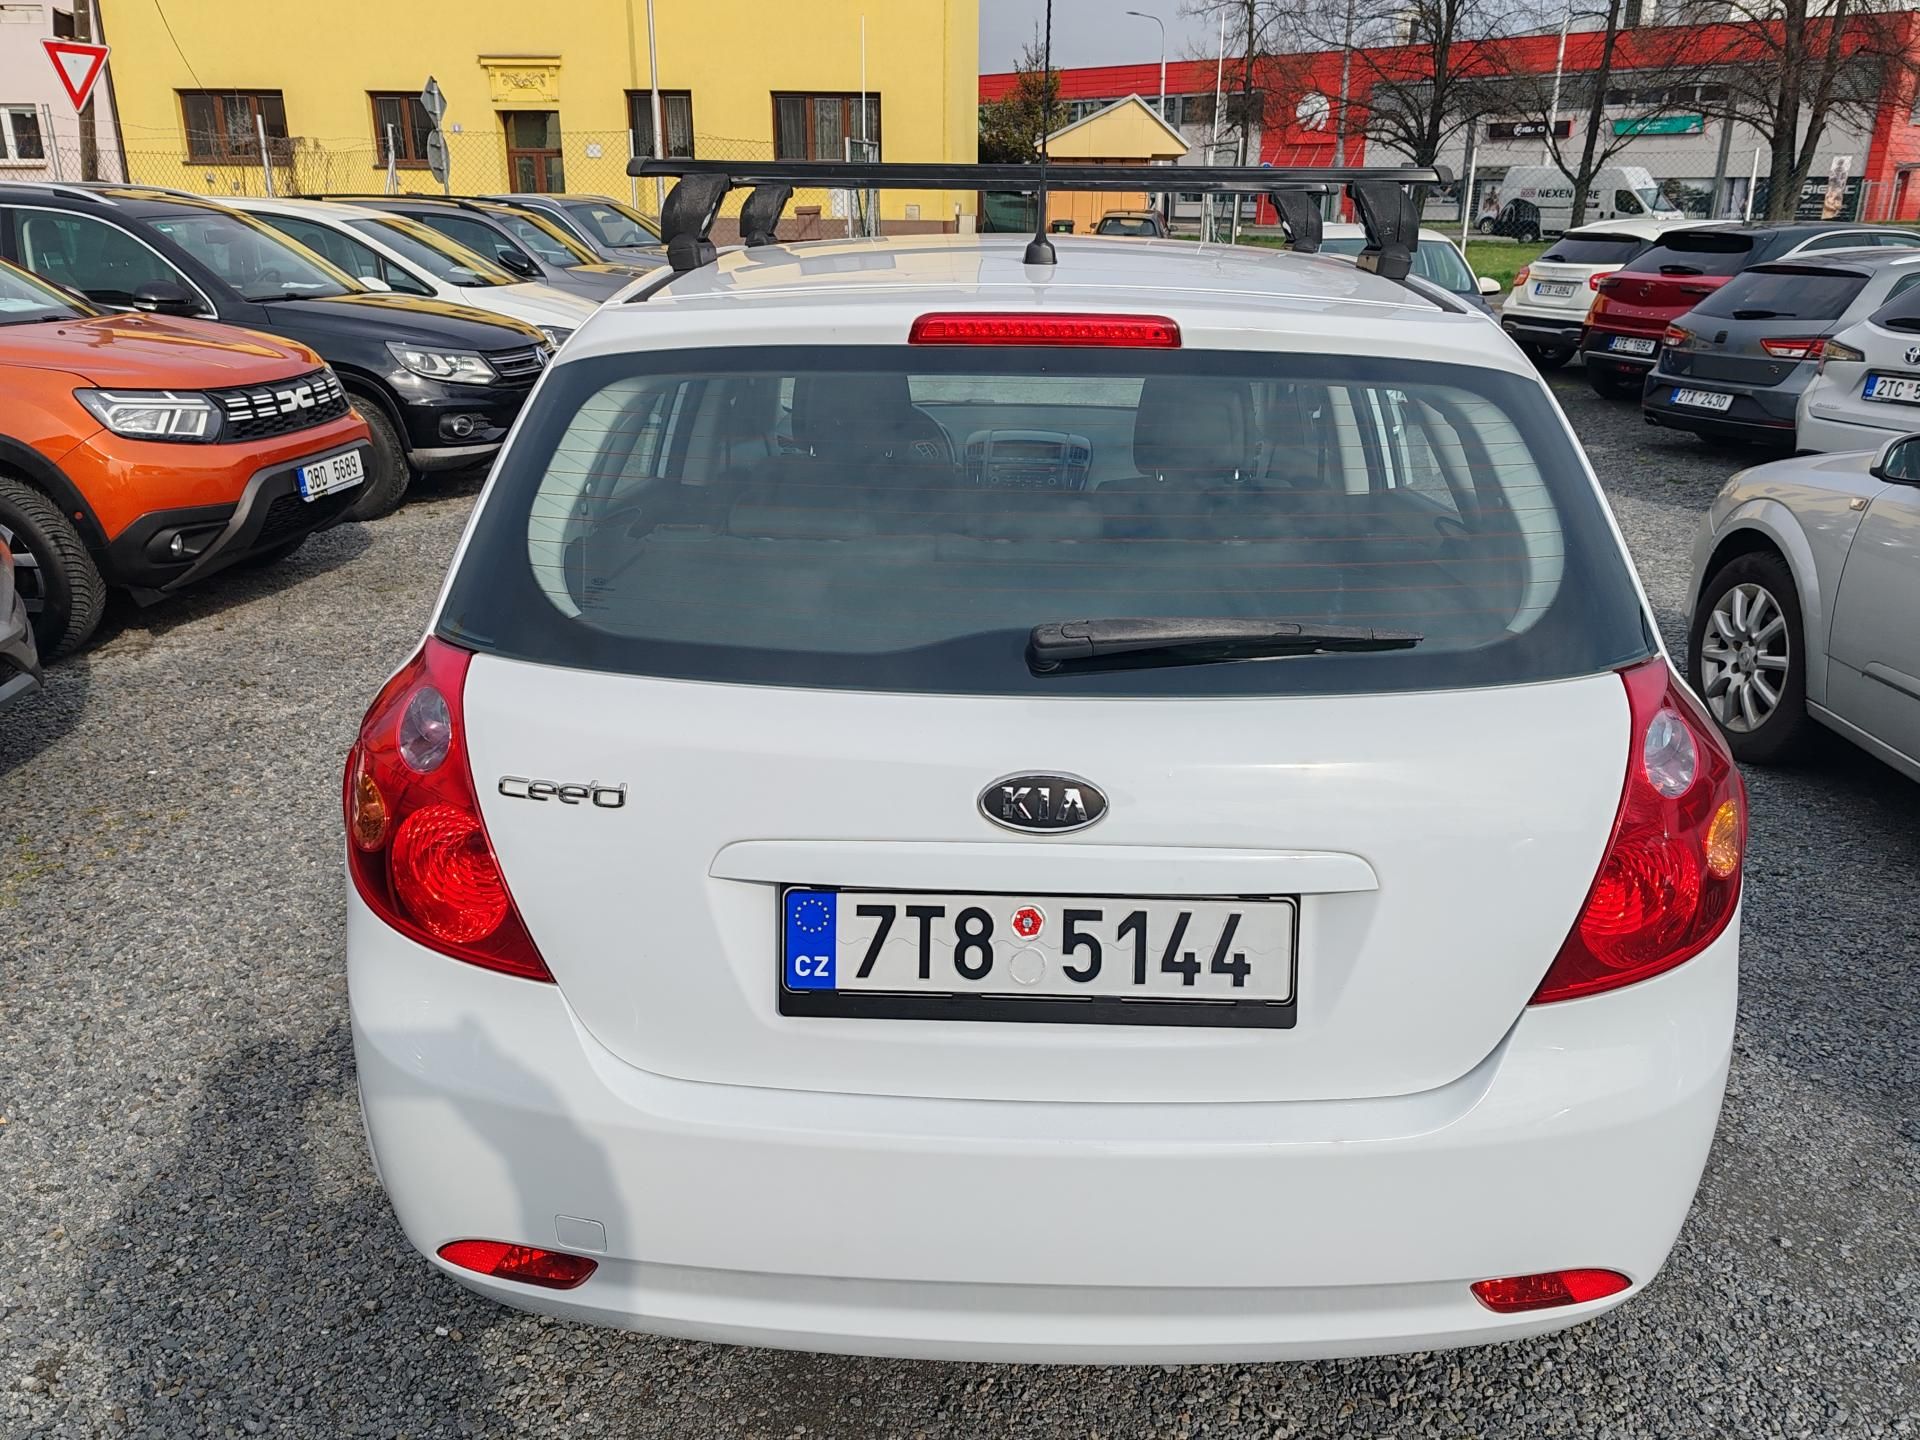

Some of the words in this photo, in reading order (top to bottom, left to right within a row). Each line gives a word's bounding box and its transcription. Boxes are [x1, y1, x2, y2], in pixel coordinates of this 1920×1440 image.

[1538, 189, 1573, 198] NEXEN
[1678, 390, 1697, 403] 2TX
[1700, 393, 1727, 408] 2430
[1876, 379, 1904, 397] 2TC
[307, 466, 328, 489] 3BD
[332, 455, 358, 481] 5689
[1001, 786, 1088, 821] KIA
[856, 904, 994, 980] 7T8
[1062, 909, 1251, 987] 5144
[794, 955, 829, 977] CZ
